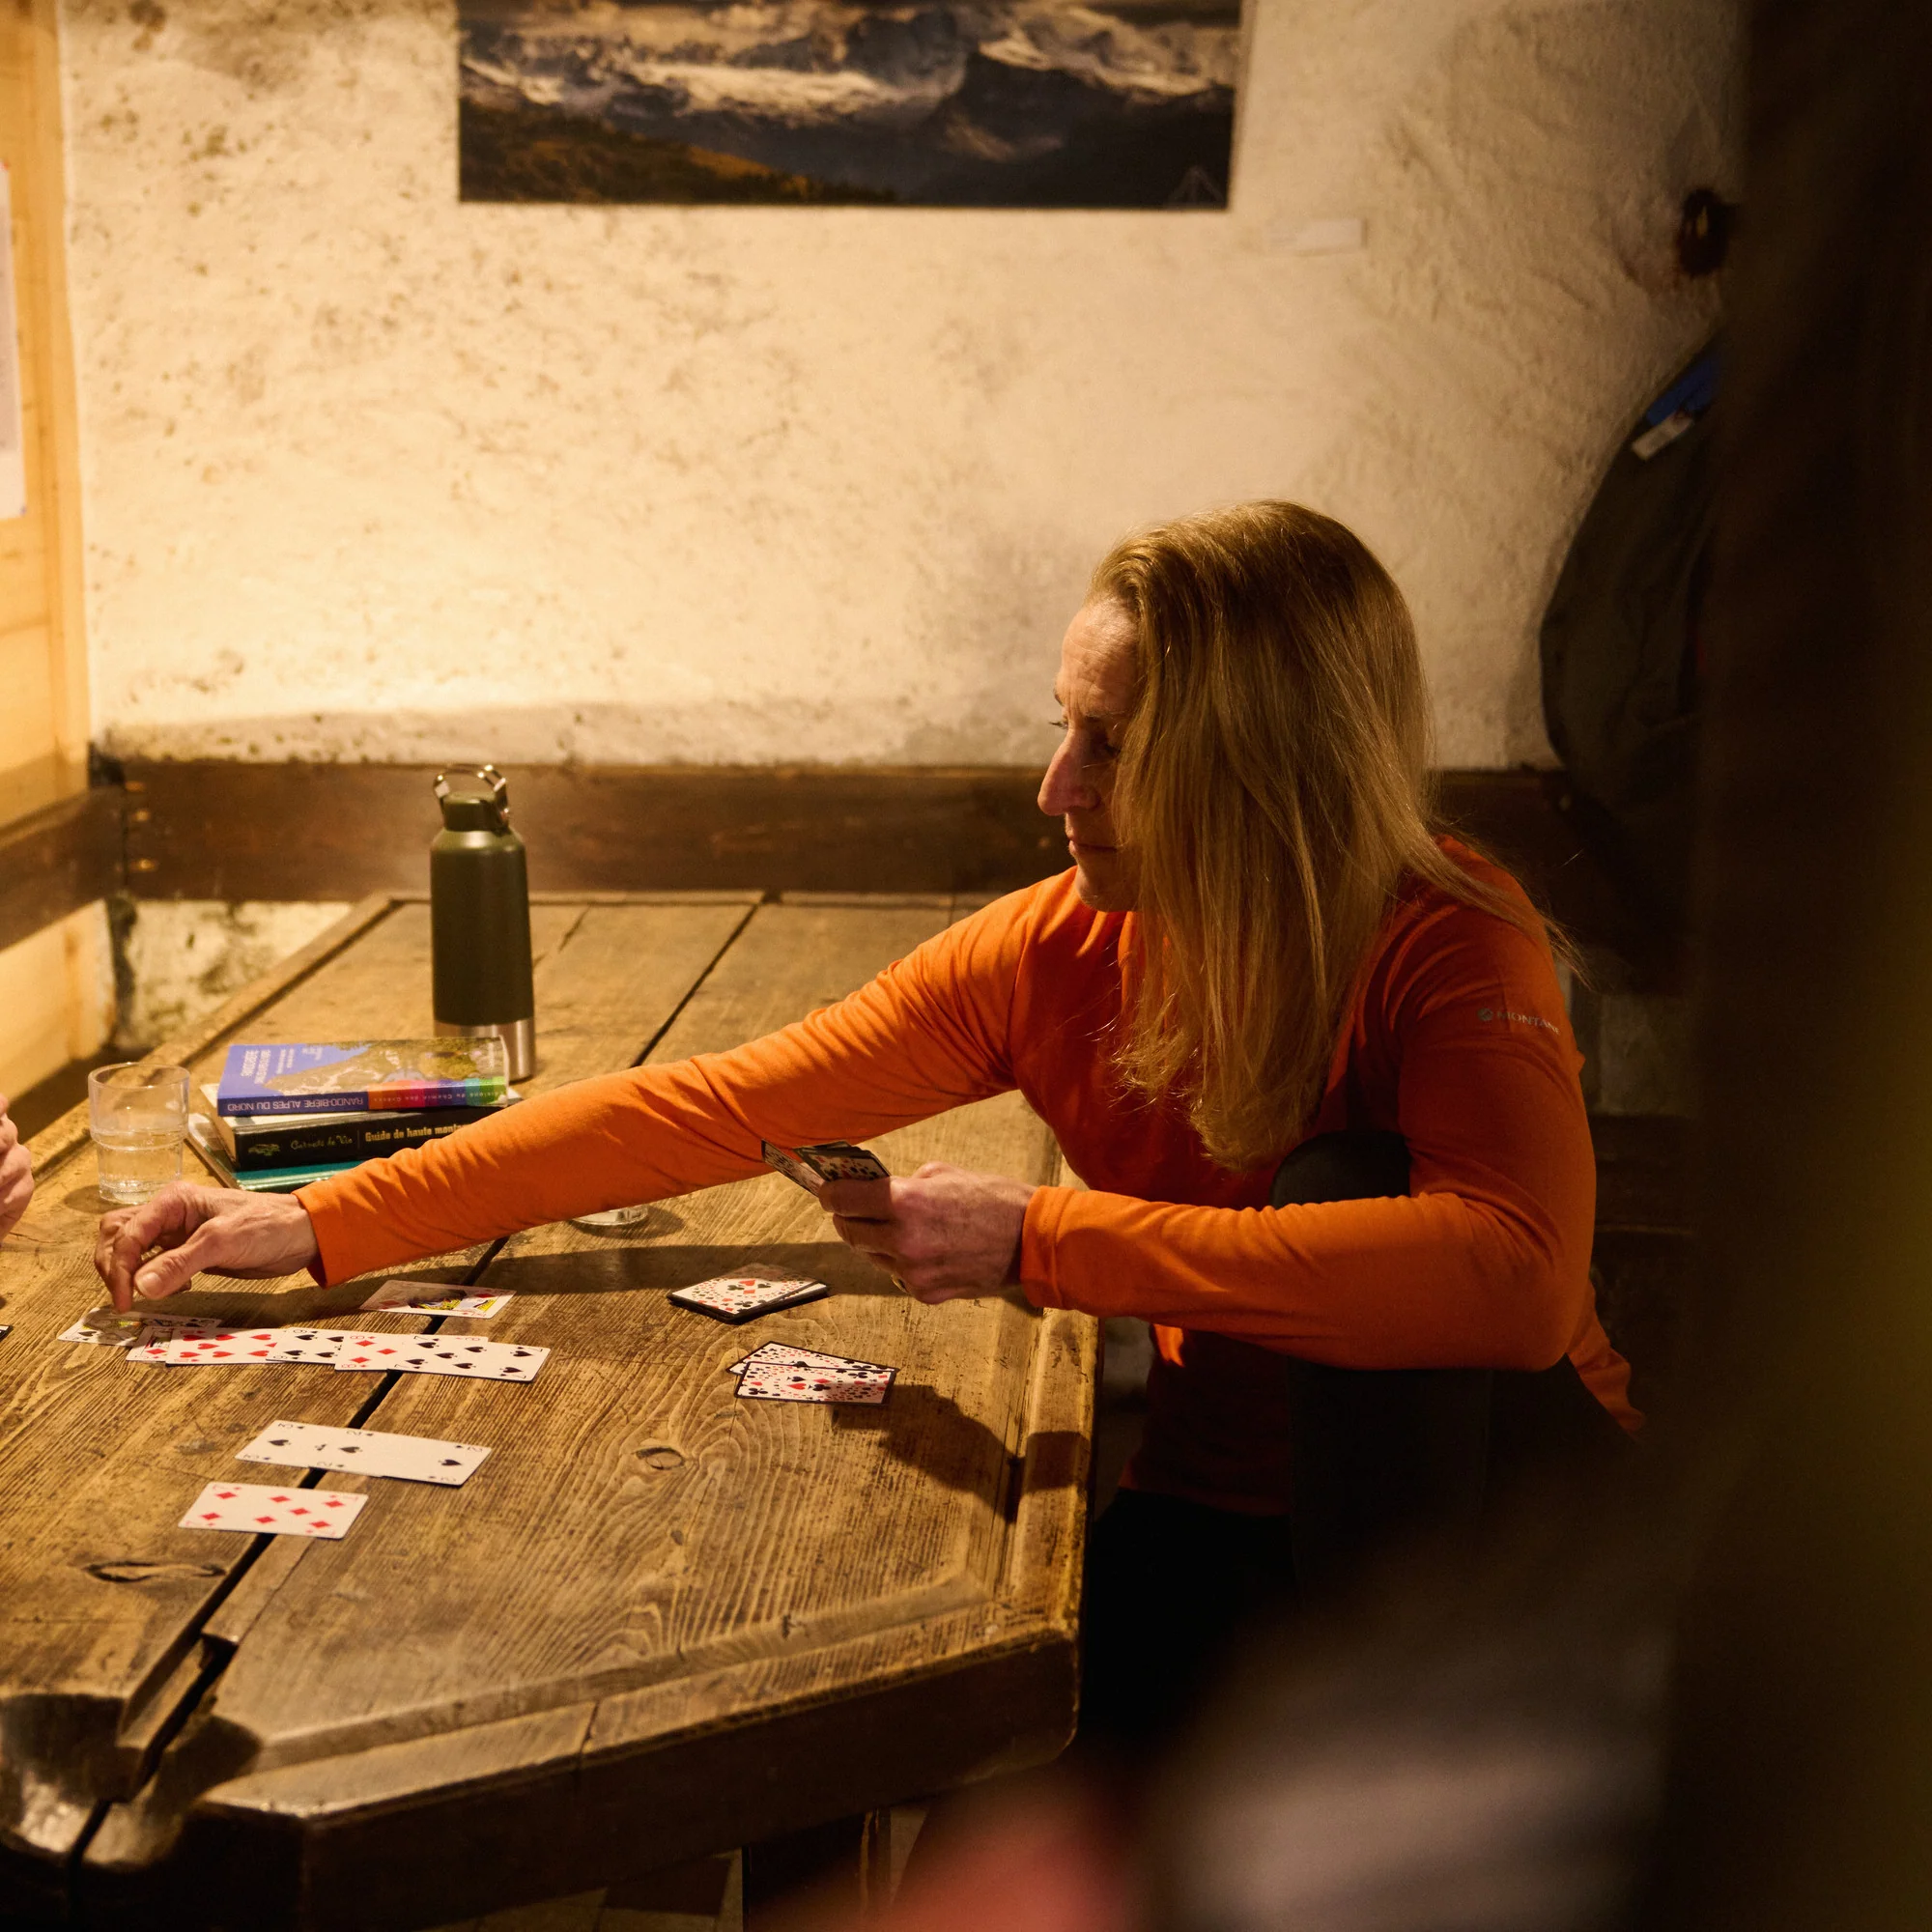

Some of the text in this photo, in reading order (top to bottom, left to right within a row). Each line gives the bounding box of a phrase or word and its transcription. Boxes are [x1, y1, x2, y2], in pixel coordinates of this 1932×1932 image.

[1496, 1011, 1561, 1036] MONTANE
[227, 1102, 255, 1112] NORD
[256, 1101, 270, 1110] DU
[272, 1100, 301, 1110] ALPES
[364, 1130, 391, 1142] Guide
[393, 1128, 405, 1139] de
[406, 1126, 433, 1138] haute
